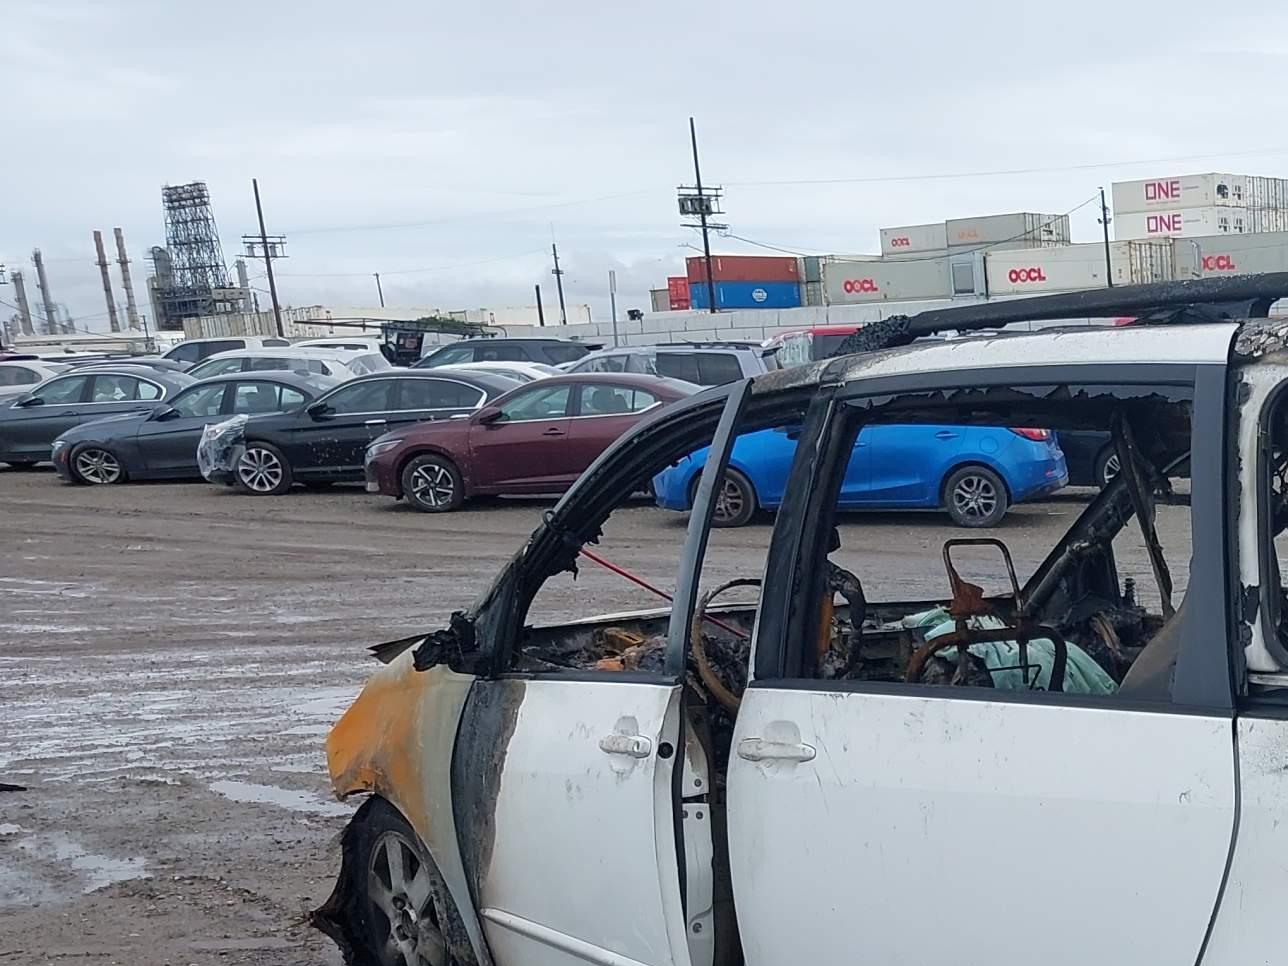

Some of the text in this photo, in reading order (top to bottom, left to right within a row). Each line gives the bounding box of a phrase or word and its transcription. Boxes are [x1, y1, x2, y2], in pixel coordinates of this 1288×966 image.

[1145, 181, 1181, 200] ONE
[1147, 214, 1182, 233] ONE
[1009, 267, 1046, 283] OOCL
[844, 278, 878, 293] OOCL
